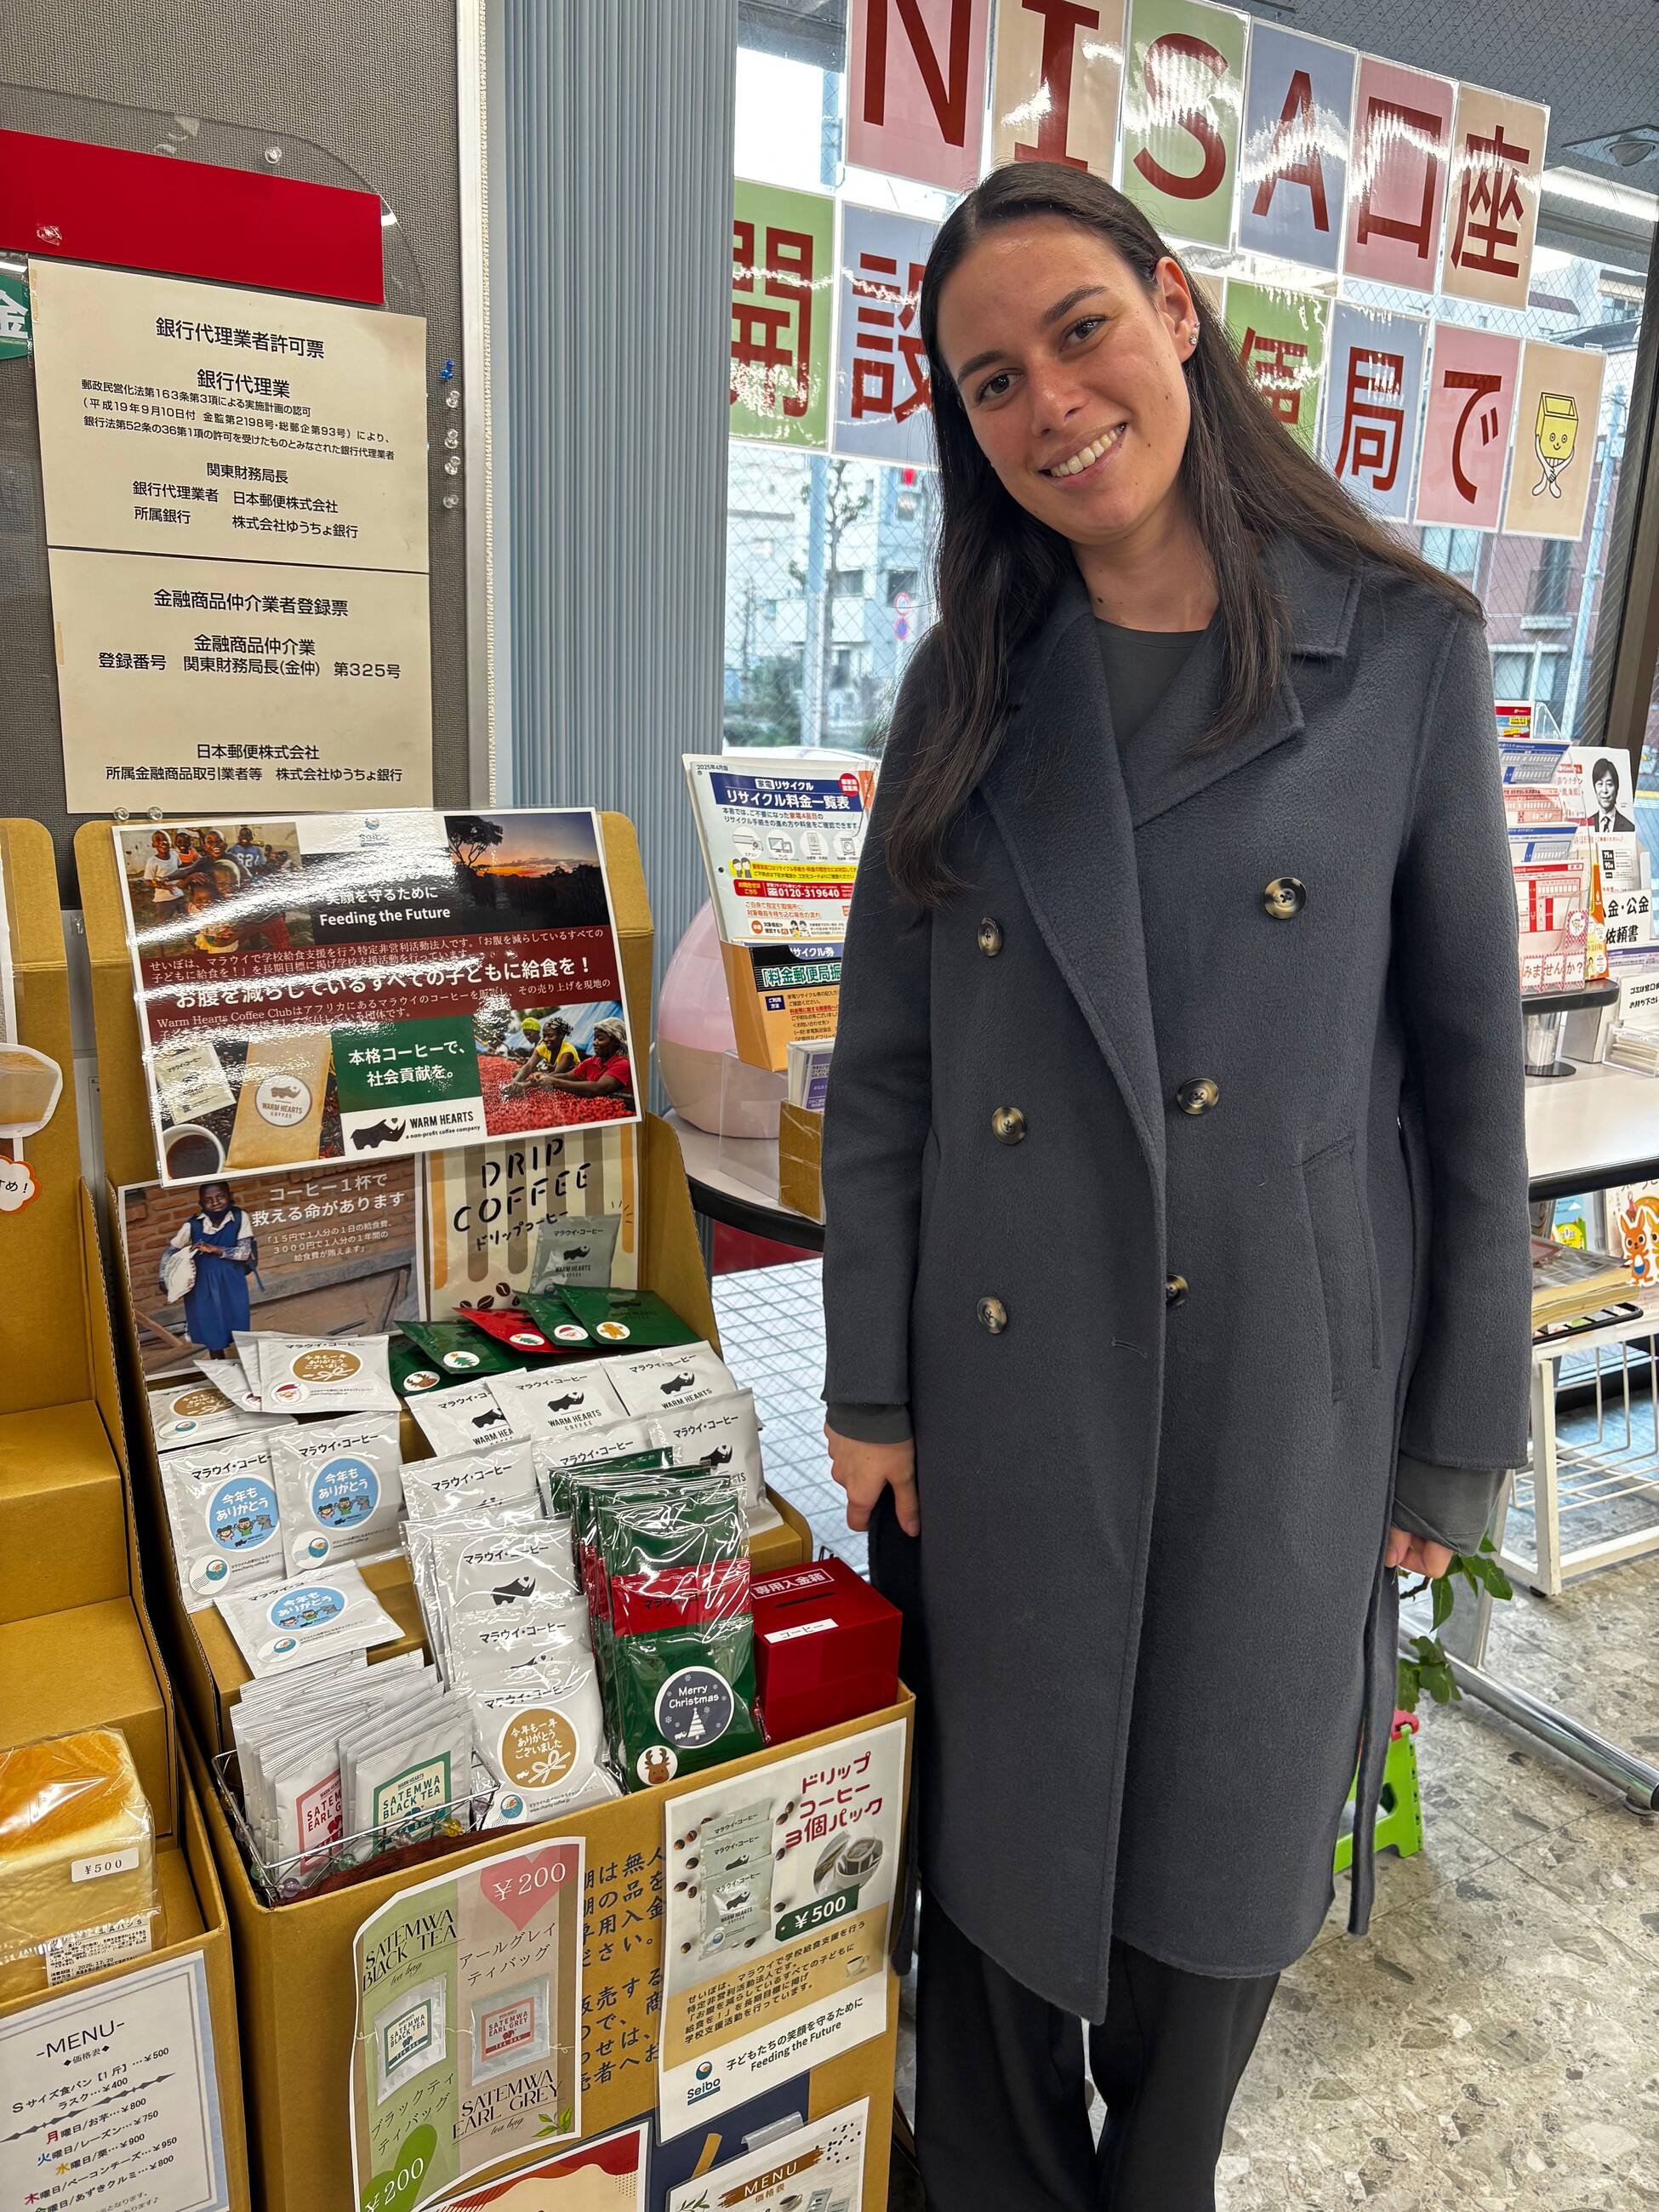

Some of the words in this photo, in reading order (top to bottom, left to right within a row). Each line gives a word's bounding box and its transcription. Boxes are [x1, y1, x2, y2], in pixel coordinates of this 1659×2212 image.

[156, 317, 324, 359] 銀行代理業者許可票
[197, 368, 289, 397] 銀行代理業
[81, 379, 311, 418] 郵政民営化法第163条第3項による実施計画の認可
[83, 416, 395, 461] 銀行法第52条の36第1項の許可を受けたものとみなされた銀行代理業者
[207, 462, 289, 484] 関東財務局長
[133, 481, 219, 504] 銀行代理業者
[233, 491, 339, 514] 日本郵便株式会社
[134, 507, 191, 525] 所属銀行
[232, 516, 358, 539] 株式会社ゆうちょ銀行
[154, 589, 349, 617] 金融商品仲介業者登録票
[193, 634, 316, 656] 金融商品仲介業
[98, 652, 166, 671] 登録番号
[183, 656, 320, 678] 関東財務局長(金仲)
[334, 661, 401, 680] 第325号
[197, 744, 320, 761] 日本郵便株式会社
[105, 767, 263, 783] 所属金融商品取引業者等
[276, 767, 403, 784] 株式会社ゆうちょ銀行
[755, 778, 813, 790] 家電リサイクル
[727, 790, 850, 809] リサイクル料金一覧表
[779, 888, 840, 898] 0120-319640
[320, 911, 377, 926] Feeding
[379, 910, 402, 922] the
[406, 908, 450, 920] Future
[1603, 896, 1649, 917] 金・公金
[1606, 925, 1639, 944] 依頼書
[790, 947, 834, 957] サイクル券
[157, 1018, 189, 1029] Warm
[192, 1014, 228, 1025] Hearts
[231, 1010, 265, 1021] Coffee
[349, 1040, 466, 1066] 本格コーヒーで、
[367, 1064, 454, 1087] 社会貢献を。
[409, 1115, 437, 1129] WARM
[440, 1111, 474, 1124] HEARTS
[411, 1131, 438, 1139] non-profit
[459, 1125, 481, 1134] company
[482, 1138, 564, 1188] DRIP
[453, 1163, 591, 1232] COFFEE
[252, 1192, 405, 1226] 救える命があります
[476, 1211, 568, 1251] ドリップコーヒー
[630, 1354, 697, 1373] マラウイ・コーヒー
[516, 1375, 588, 1391] マラウイ・コーヒー
[438, 1392, 492, 1410] マラウイ・コ
[661, 1399, 685, 1410] WARM
[687, 1388, 713, 1402] HEARTS
[548, 1416, 573, 1428] WARM
[572, 1409, 602, 1423] HEARTS
[674, 1416, 738, 1438] マラウイ・コーヒー
[299, 1434, 379, 1457] マラウイ・コーヒー
[473, 1433, 497, 1445] WARM
[499, 1428, 514, 1440] HEA
[325, 1468, 358, 1484] 今年も
[431, 1464, 512, 1491] マラウイ・コーヒー
[222, 1487, 258, 1503] 今年も
[318, 1479, 368, 1499] ありがとう
[216, 1499, 269, 1522] ありがとう
[755, 1572, 826, 1595] 専用入金箱
[480, 1622, 567, 1644] マラウイ・コーヒー
[780, 1623, 824, 1639] コーヒー
[670, 1693, 719, 1709] Christmas
[679, 1685, 708, 1696] Merry
[510, 1718, 558, 1737] 今年も一年
[517, 1729, 556, 1747] ありがとう
[515, 1740, 563, 1759] ございました
[409, 1773, 425, 1783] HEARTS
[802, 1751, 871, 1794] ドリップ
[383, 1775, 440, 1810] SATEMWA
[383, 1796, 417, 1820] BLACK
[421, 1785, 441, 1801] TEA
[800, 1783, 870, 1819] コーヒー
[307, 1789, 342, 1821] SATEM
[308, 1811, 333, 1833] EARL
[785, 1797, 883, 1849] 3個パック
[85, 1859, 123, 1875] ¥500
[795, 1896, 847, 1930] ¥500
[366, 1909, 453, 1970] SATEMWA
[459, 1922, 556, 1970] アールグレイ
[363, 1942, 408, 1992] BLACK
[417, 1924, 457, 1951] TEA
[467, 1943, 550, 1987] ティバッグ
[390, 2014, 425, 2040] SATEMWA
[413, 2021, 425, 2034] TEA
[488, 2010, 529, 2030] SATEMWA
[488, 2026, 507, 2037] EARL
[509, 2016, 528, 2029] GREY
[726, 1997, 864, 2071] 子どもたちの笑顔を守るために
[750, 2047, 790, 2072] Feeding
[791, 2039, 808, 2052] the
[810, 2021, 841, 2043] Future
[462, 2069, 554, 2117] SATEMWA
[687, 2078, 721, 2099] Seibo
[371, 2072, 454, 2141] ブラックティ
[453, 2107, 502, 2140] EARL
[509, 2079, 563, 2112] GREY
[379, 2092, 451, 2156] ティバッグ
[744, 2162, 798, 2198] MENU
[755, 2182, 786, 2203] 価格表
